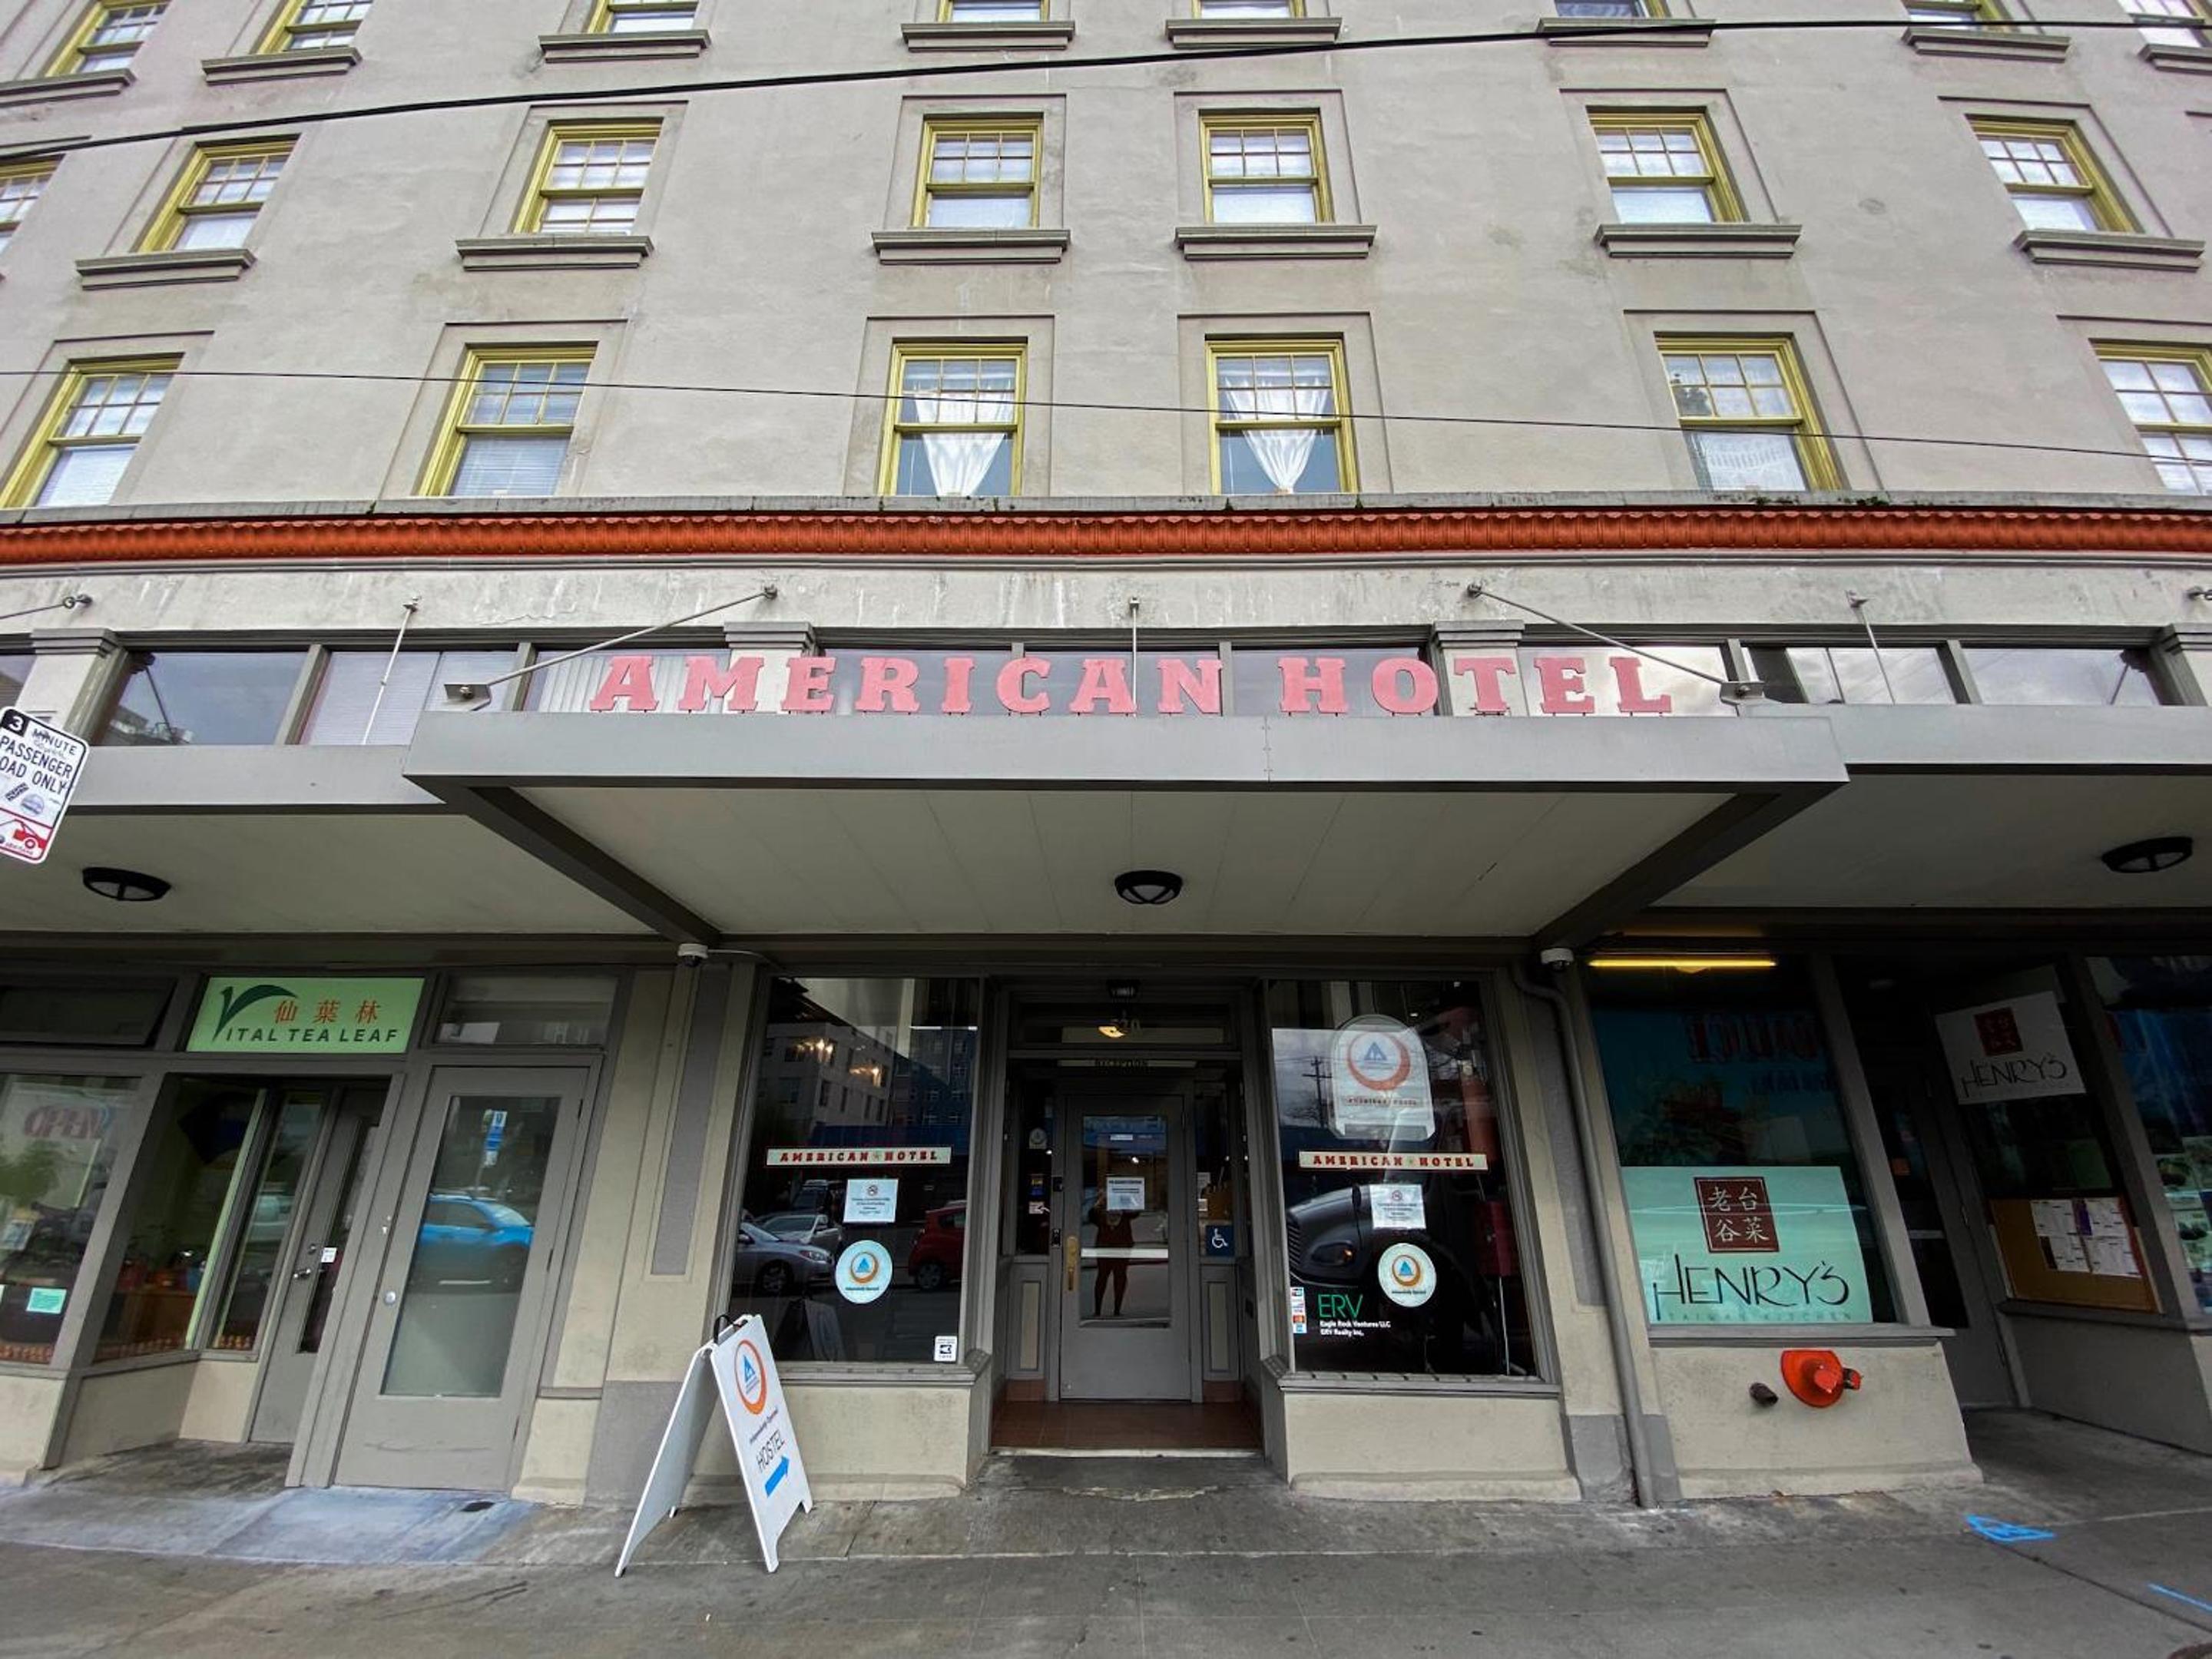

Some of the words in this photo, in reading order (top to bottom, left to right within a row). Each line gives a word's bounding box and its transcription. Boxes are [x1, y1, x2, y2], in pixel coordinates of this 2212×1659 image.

[589, 657, 1223, 714] AMERICAN
[1278, 657, 1672, 714] HOTEL
[9, 716, 24, 730] 3
[0, 736, 74, 779] PASSENGER
[0, 757, 28, 778] OAD
[32, 770, 67, 795] ONLY
[285, 1028, 329, 1042] TEA
[339, 1027, 399, 1042] LEAF
[780, 1152, 869, 1163] AMERICAN
[884, 1151, 938, 1161] HOTEL
[1313, 1155, 1403, 1166] AMERICAN
[1419, 1157, 1475, 1167] HOTEL
[1318, 1293, 1363, 1319] ERV
[756, 1429, 785, 1473] HOSTEL
